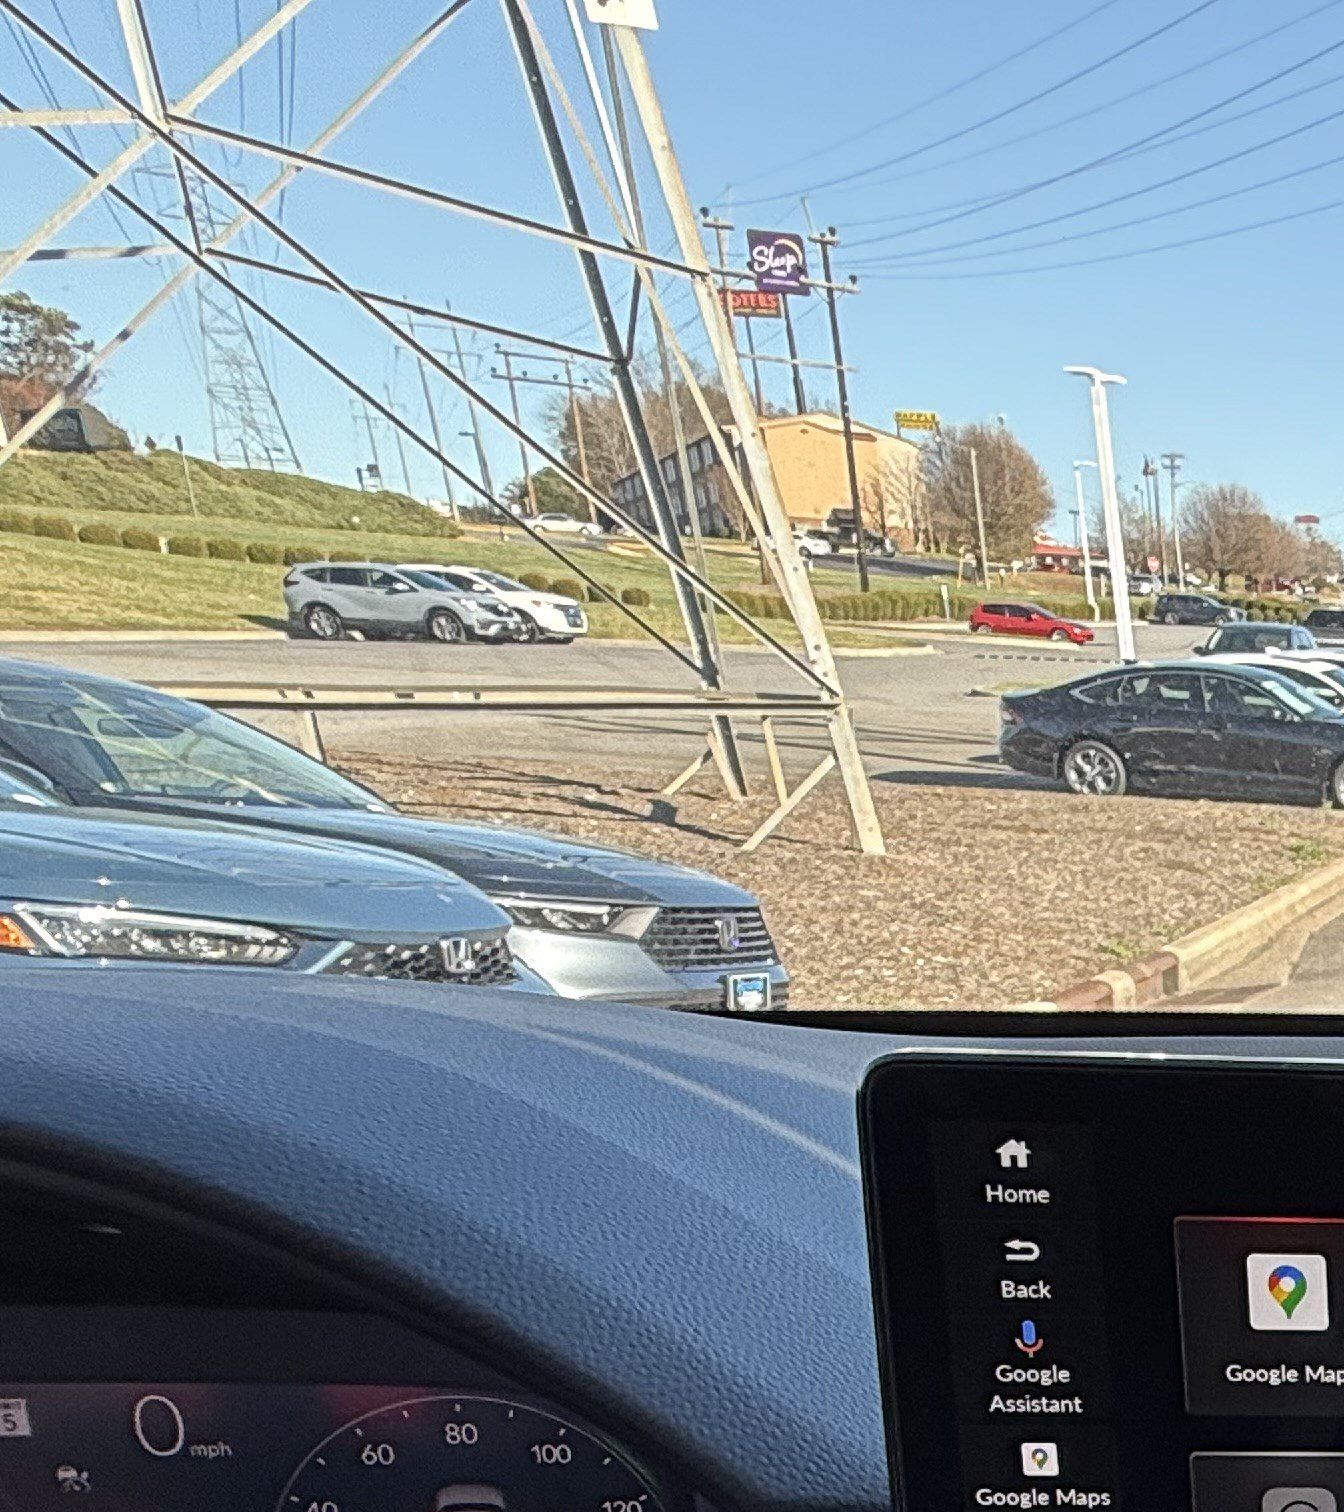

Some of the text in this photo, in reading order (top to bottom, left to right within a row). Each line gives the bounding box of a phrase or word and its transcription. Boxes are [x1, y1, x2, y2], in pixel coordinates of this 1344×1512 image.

[985, 1184, 1051, 1205] Home
[1000, 1278, 1052, 1300] Back
[995, 1364, 1072, 1389] Google
[1225, 1365, 1299, 1388] Google
[989, 1394, 1083, 1414] Assistant
[134, 1395, 233, 1461] 0 mph
[444, 1424, 478, 1445] 80
[361, 1443, 395, 1465] 60
[530, 1443, 573, 1465] 100
[975, 1488, 1112, 1512] Google Maps
